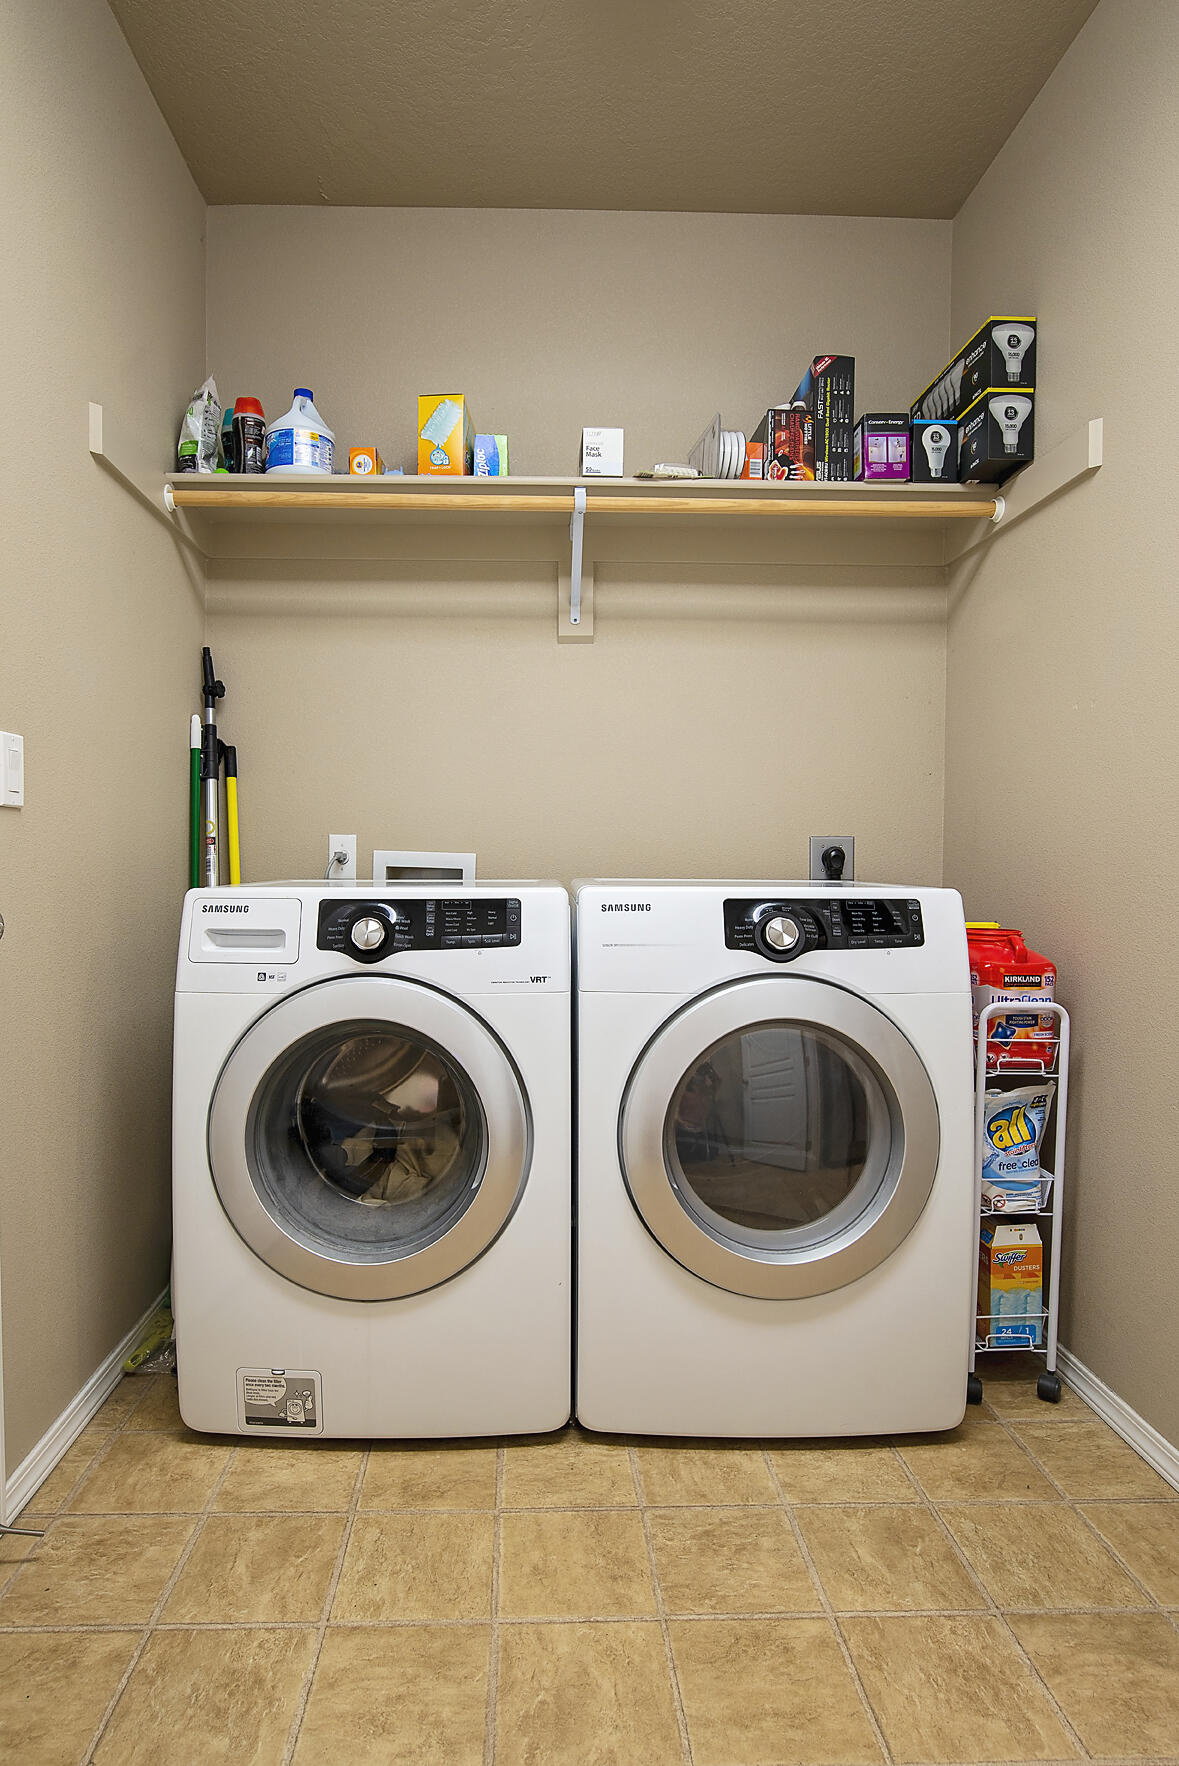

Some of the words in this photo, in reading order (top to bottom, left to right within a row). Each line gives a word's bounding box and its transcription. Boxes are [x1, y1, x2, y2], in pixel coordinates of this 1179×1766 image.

[476, 448, 491, 477] Ziploc
[201, 904, 250, 913] SAMSUNG
[601, 903, 651, 912] SAMSUNG
[1004, 975, 1041, 984] KIRKLAND
[1044, 975, 1054, 983] 152
[991, 994, 1052, 1004] UltraClean
[989, 1105, 1032, 1150] all
[998, 1161, 1017, 1171] free
[1021, 1158, 1039, 1168] clea
[992, 1250, 1027, 1266] Swiffer
[1013, 1264, 1040, 1272] DUSTERS
[1001, 1328, 1012, 1336] 24
